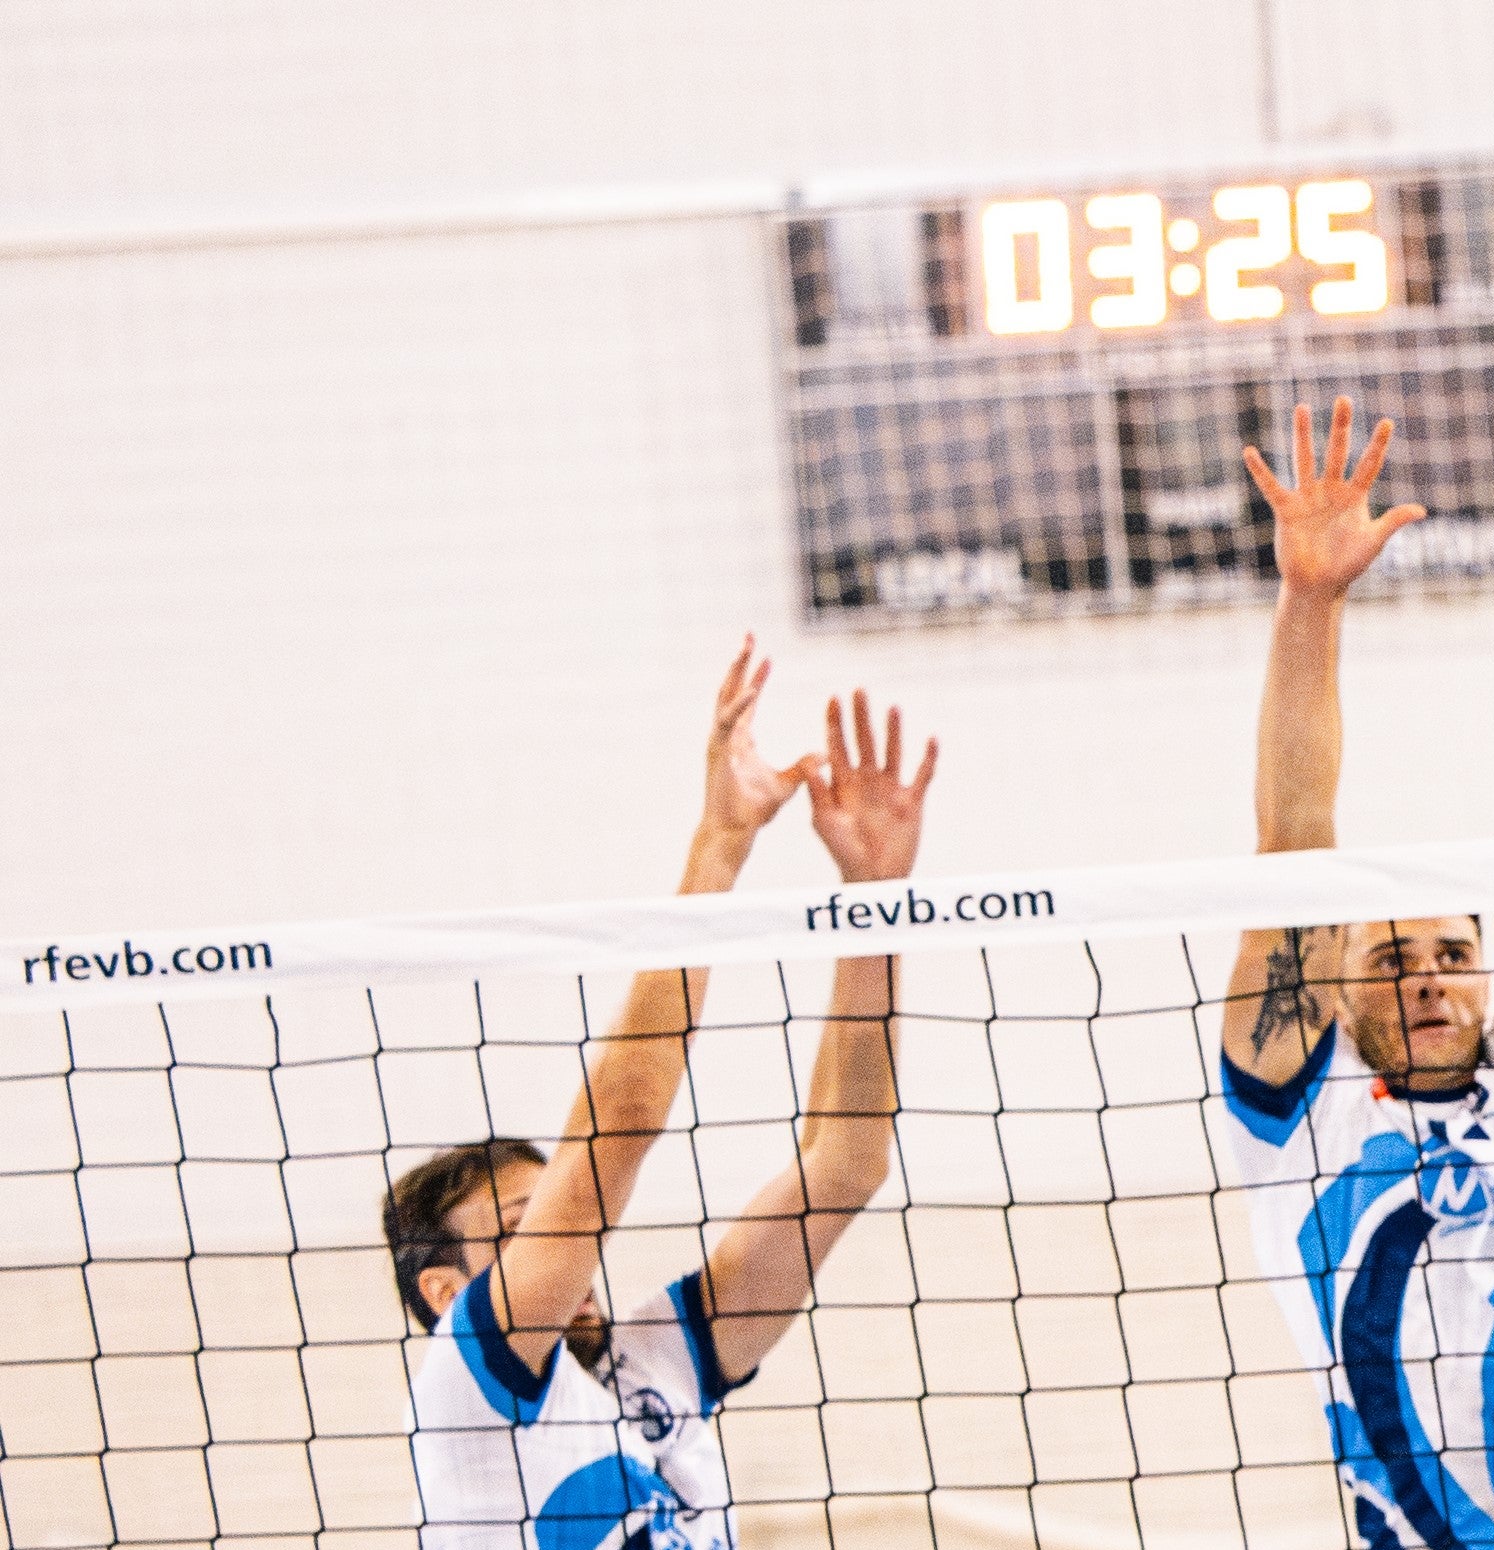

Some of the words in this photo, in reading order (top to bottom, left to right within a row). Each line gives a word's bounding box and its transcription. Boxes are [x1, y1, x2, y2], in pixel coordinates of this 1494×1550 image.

[983, 180, 1388, 335] 03:25
[805, 888, 1056, 931] rfevb.com
[22, 937, 273, 986] rfevb.com
